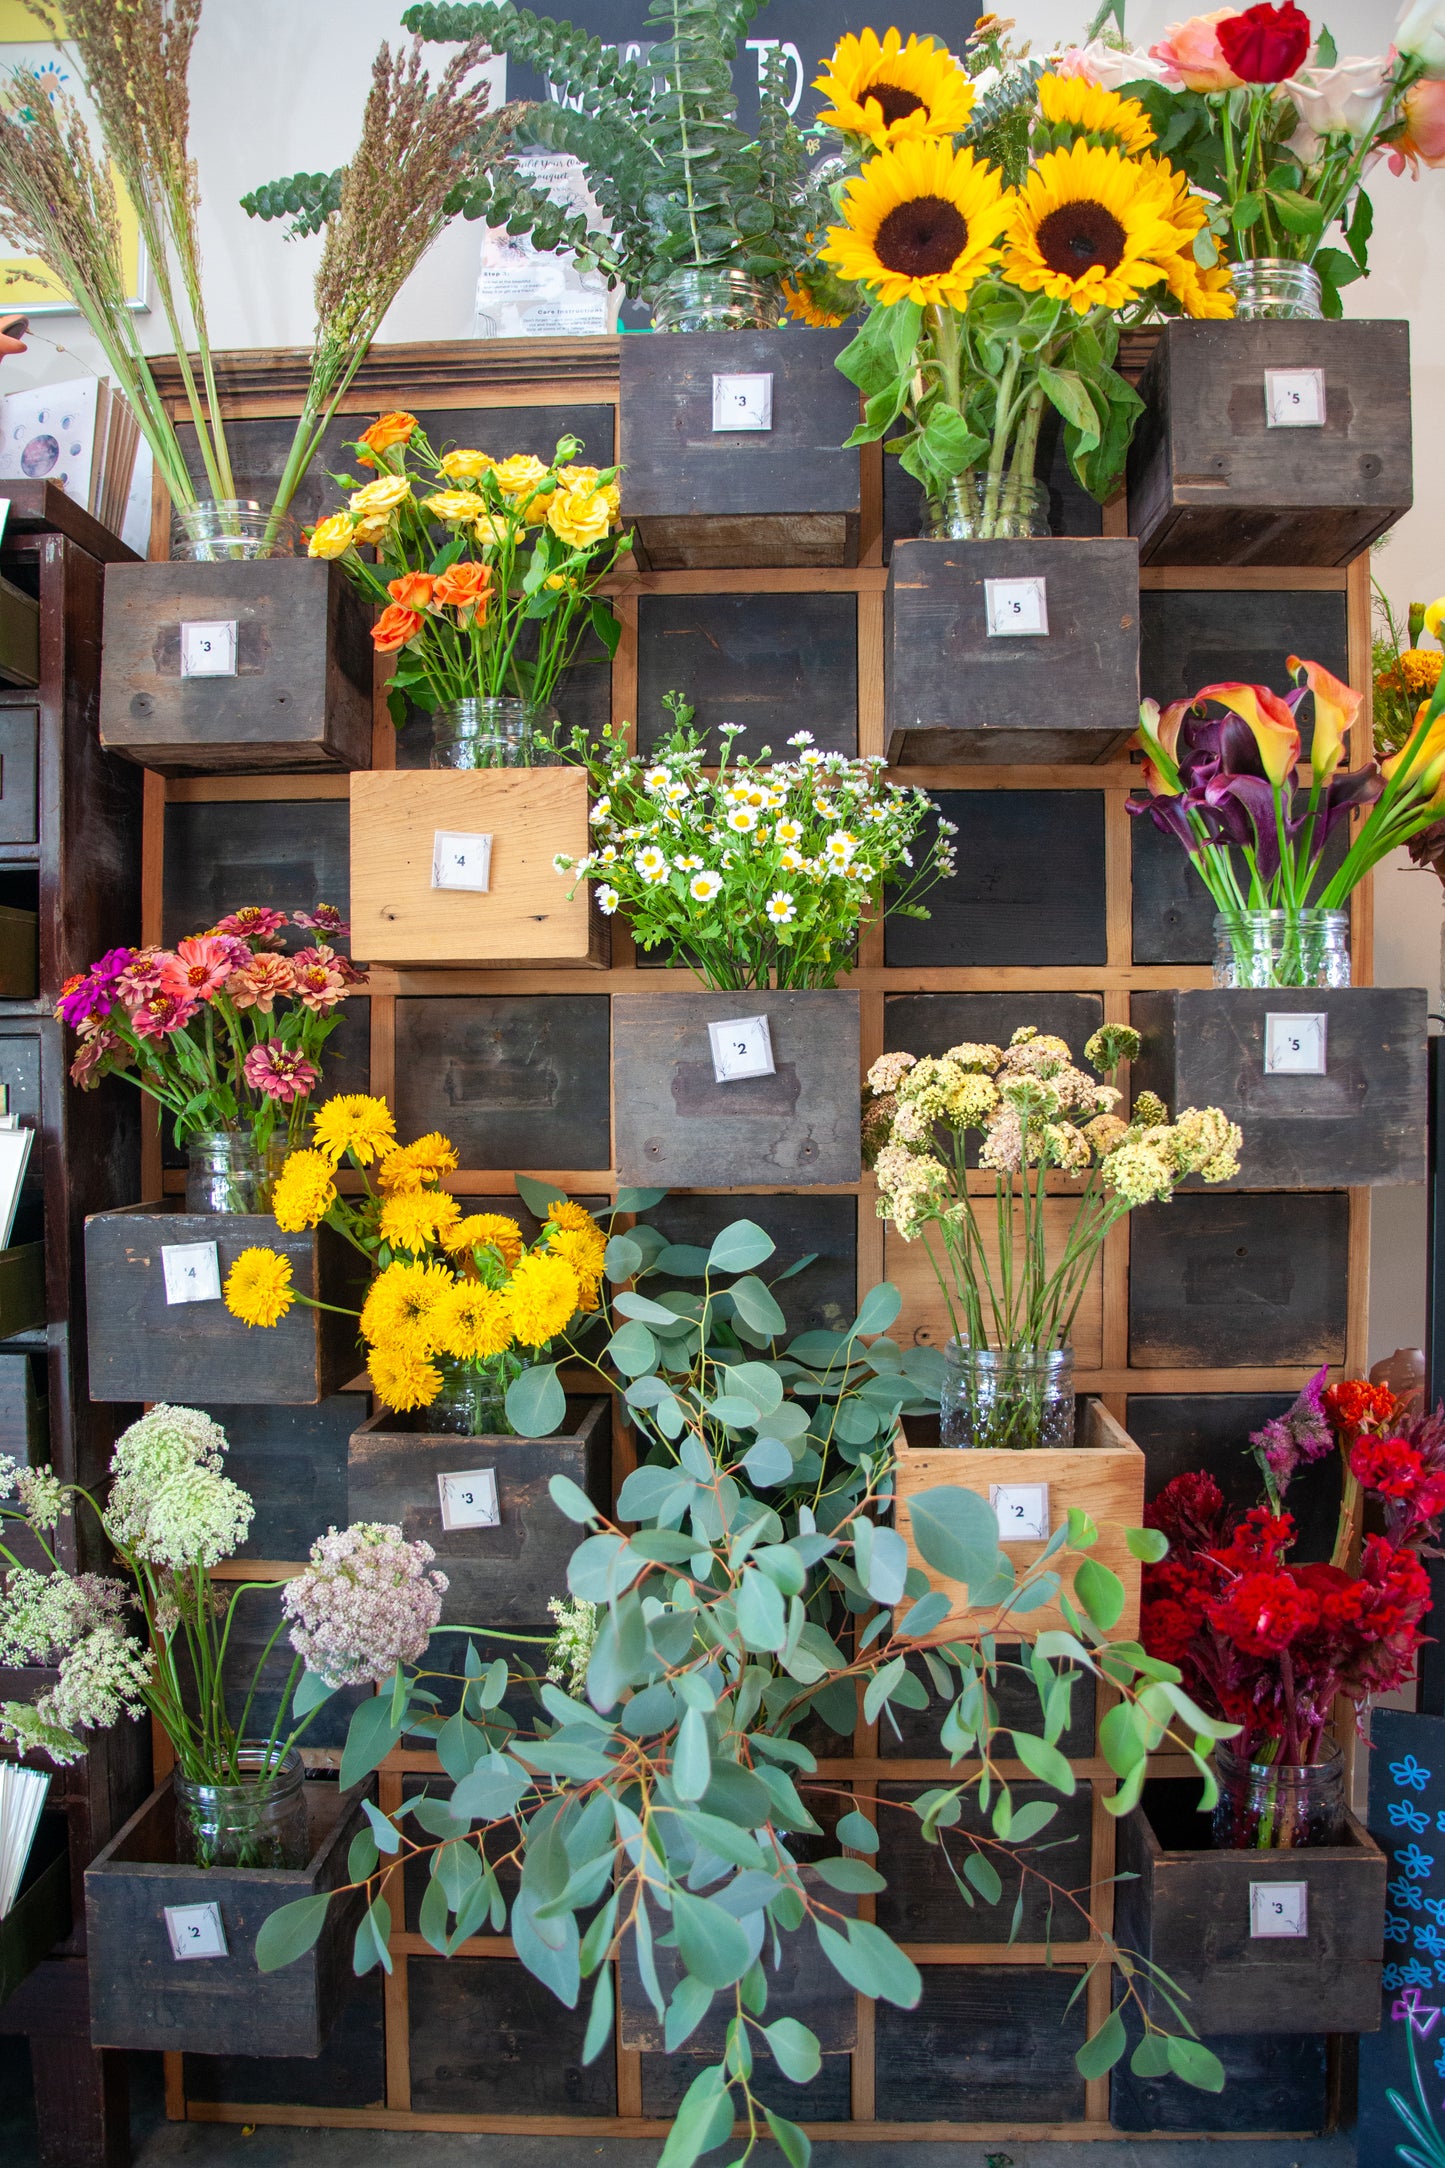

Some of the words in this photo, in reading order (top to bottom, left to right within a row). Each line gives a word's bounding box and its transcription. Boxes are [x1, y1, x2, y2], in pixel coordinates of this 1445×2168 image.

[517, 159, 538, 168] uild
[541, 159, 563, 169] Your
[527, 171, 568, 182] Bouquet
